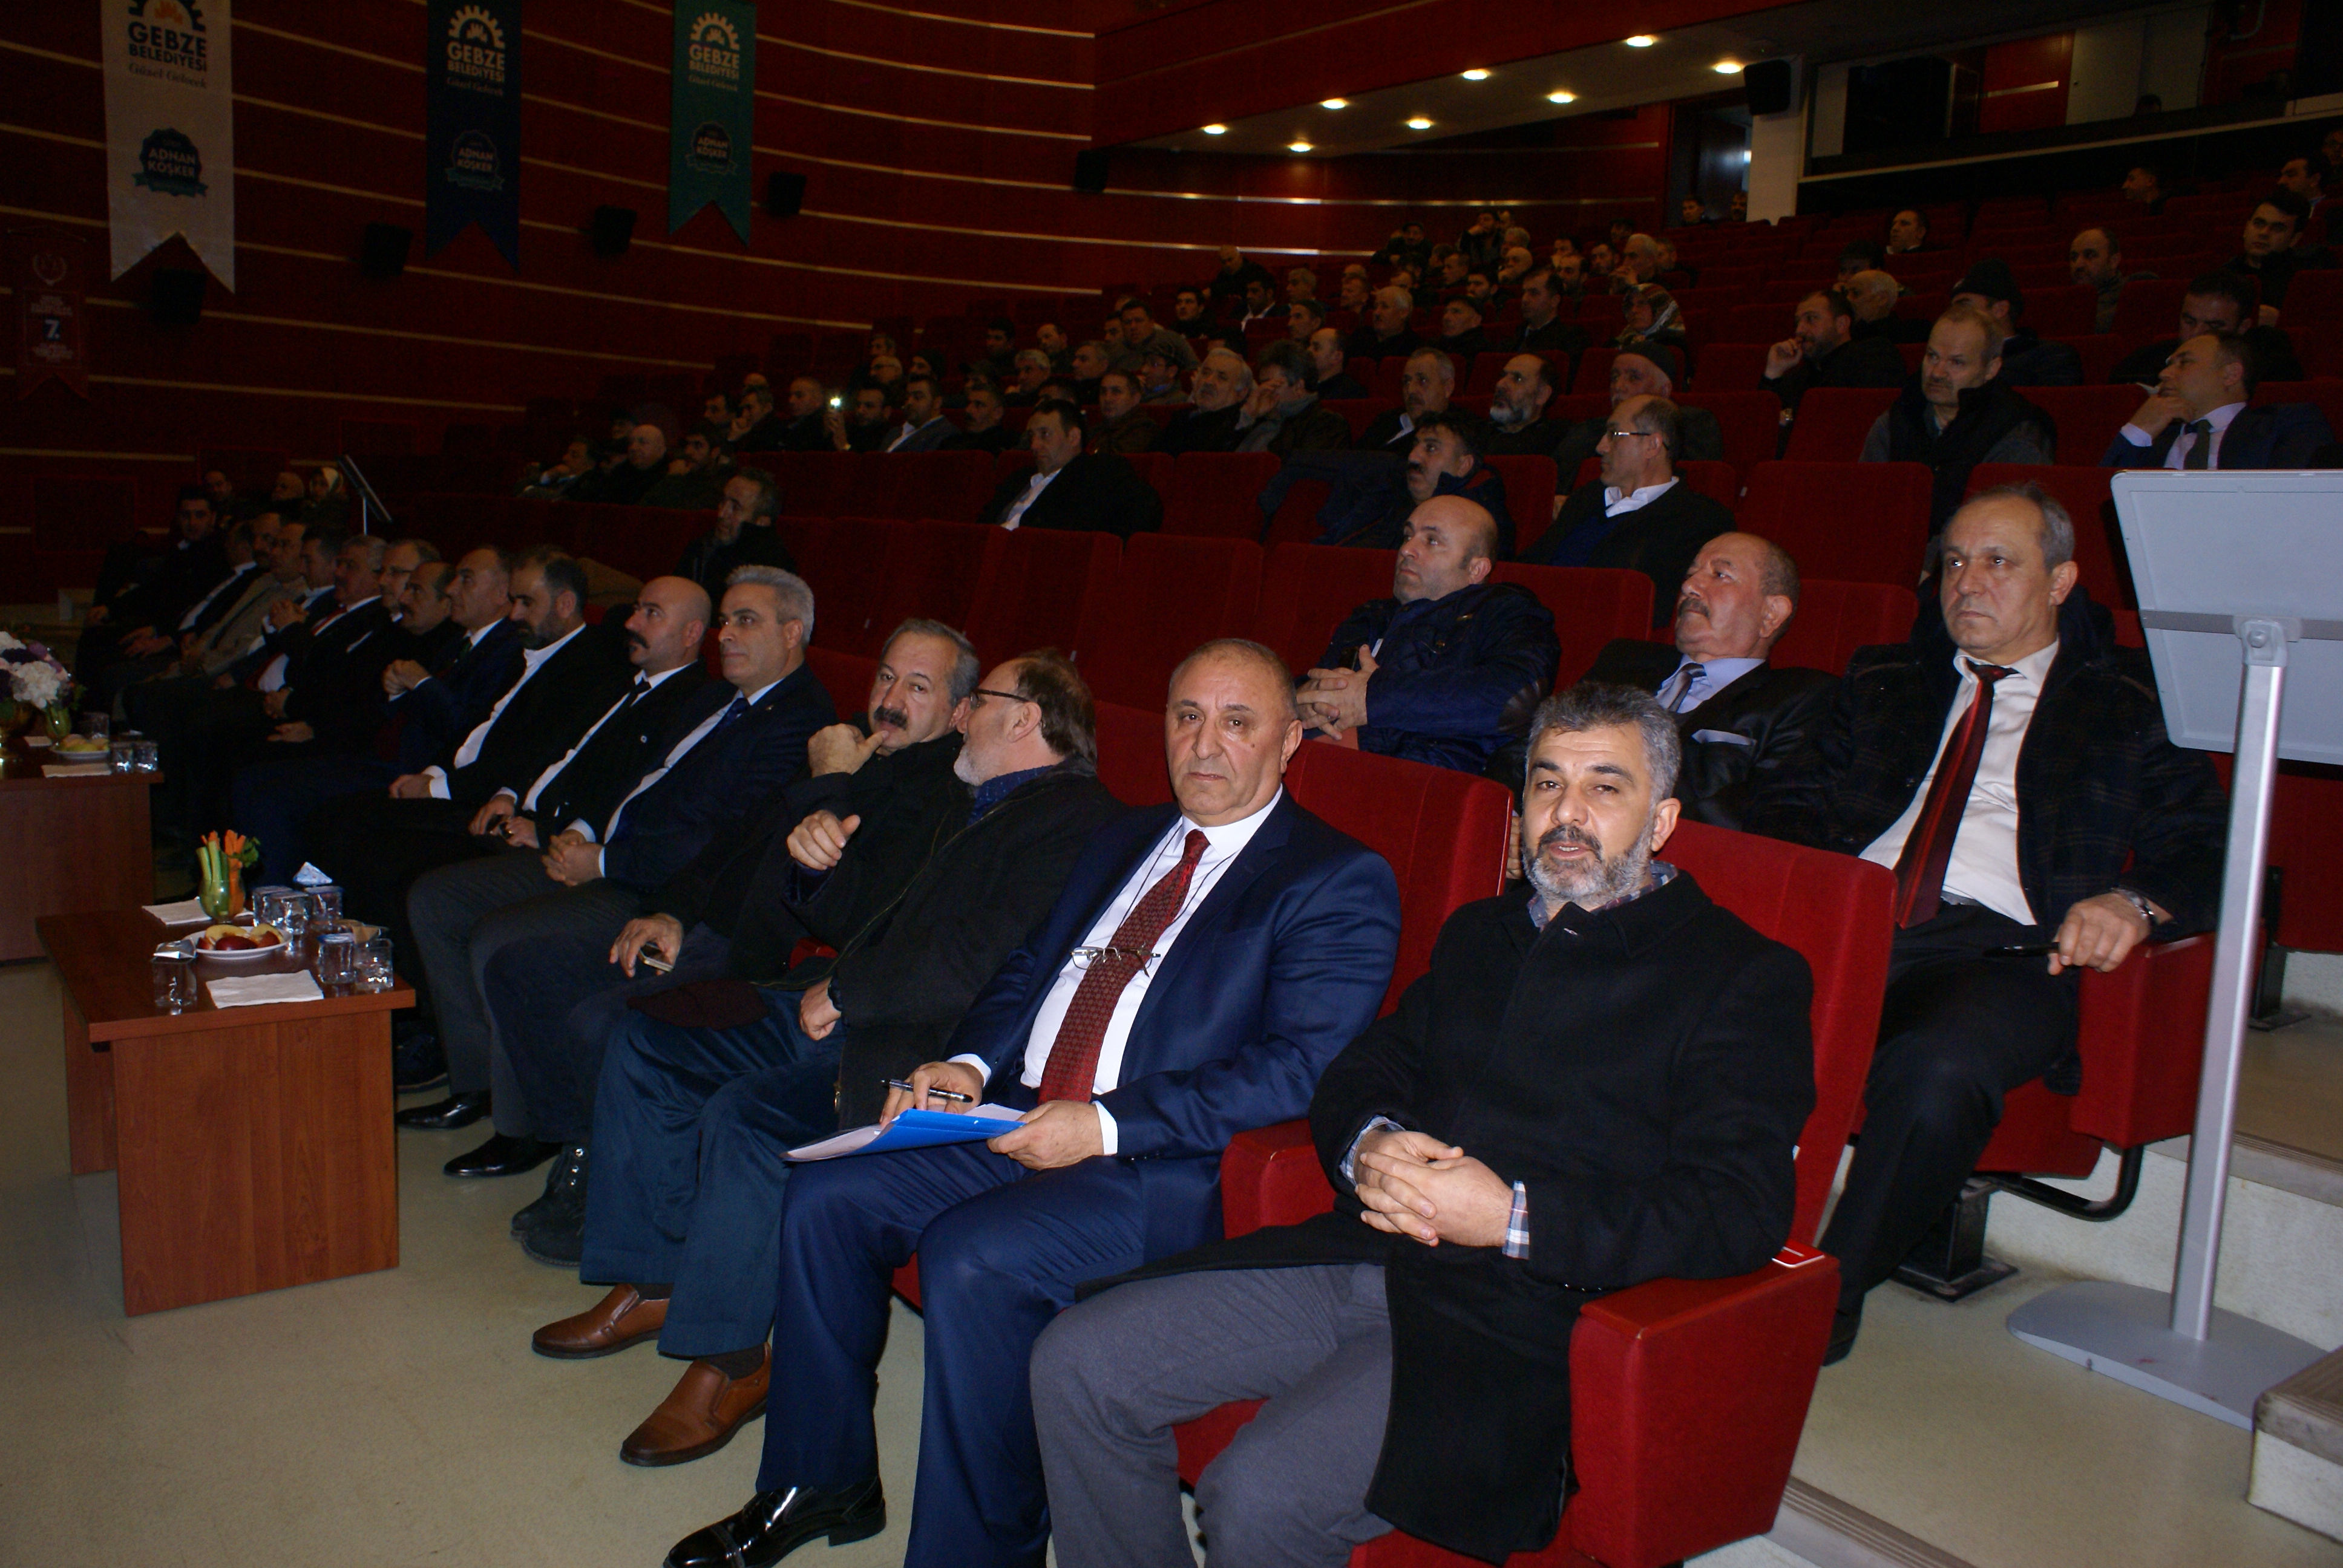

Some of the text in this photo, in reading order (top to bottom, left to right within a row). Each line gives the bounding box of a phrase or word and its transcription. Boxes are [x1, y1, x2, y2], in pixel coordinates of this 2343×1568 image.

[129, 21, 206, 58] GEBZE
[447, 41, 505, 71] GEBZE
[689, 43, 739, 70] GEBZE
[147, 160, 195, 177] KOŞKER
[148, 147, 195, 165] ADNAN
